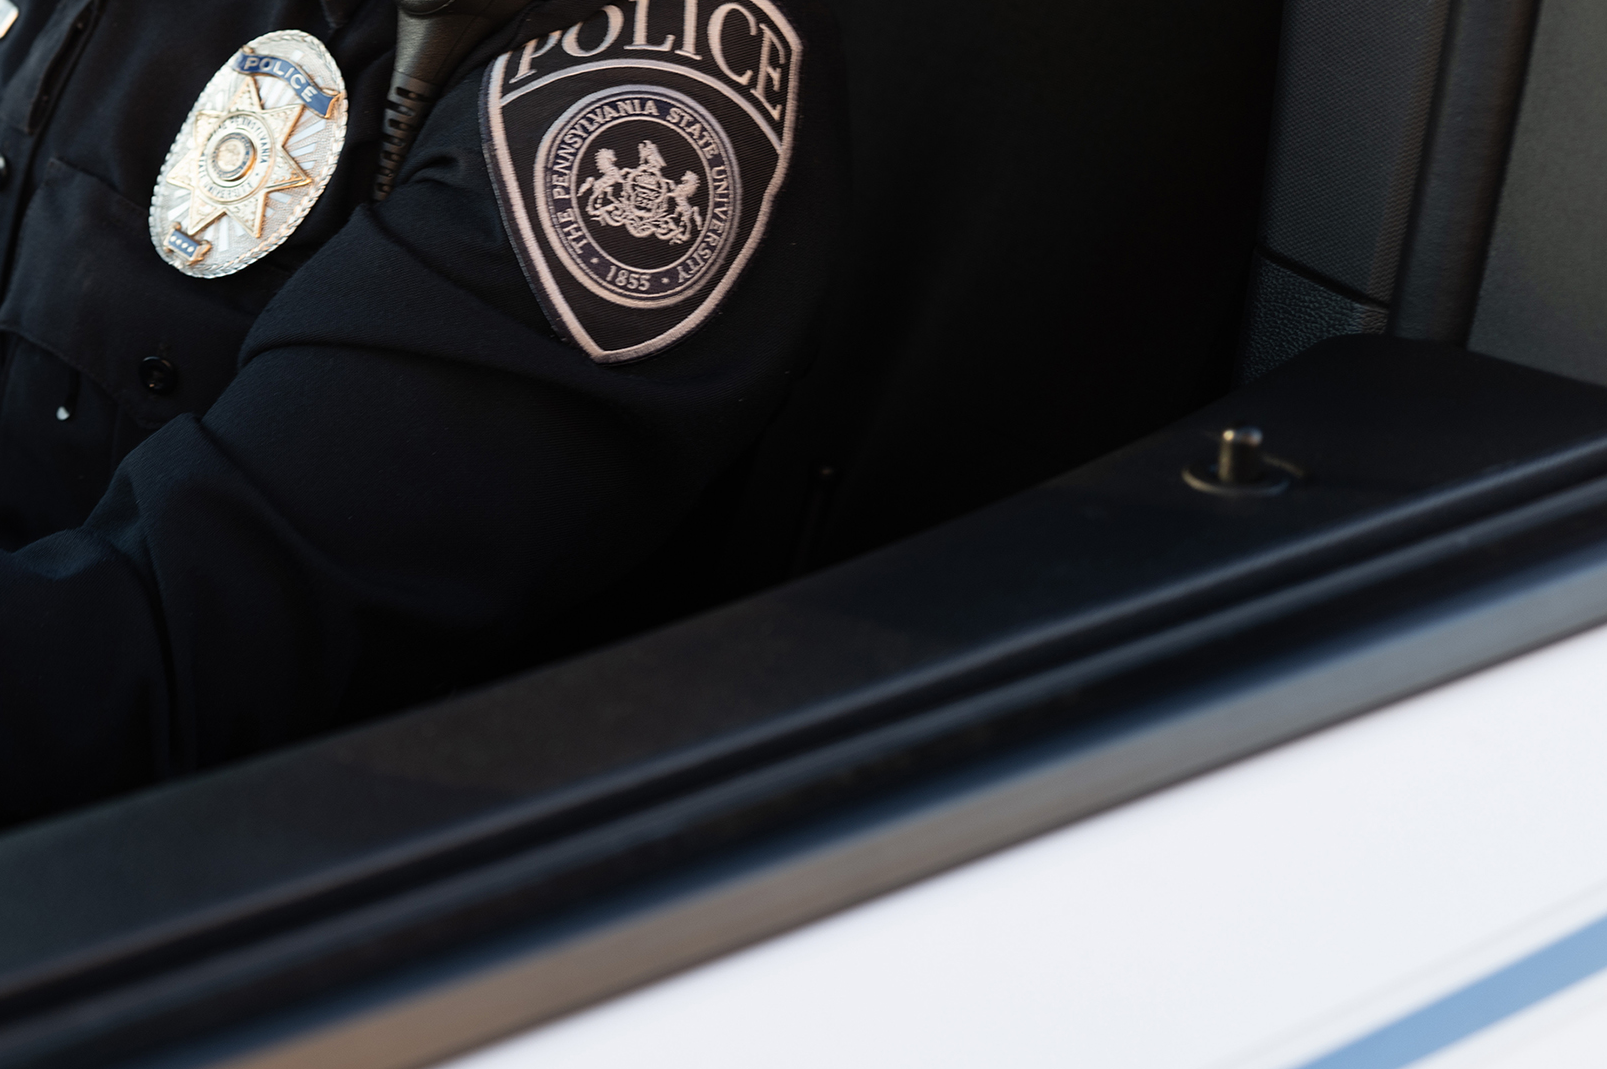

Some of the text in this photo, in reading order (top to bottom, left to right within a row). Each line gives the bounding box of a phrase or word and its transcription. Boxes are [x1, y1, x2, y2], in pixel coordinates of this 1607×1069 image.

[243, 56, 318, 103] POLICE
[552, 98, 730, 284] THE PENNSYLVANIA STATE UNIVERSITY
[604, 264, 652, 292] 1855
